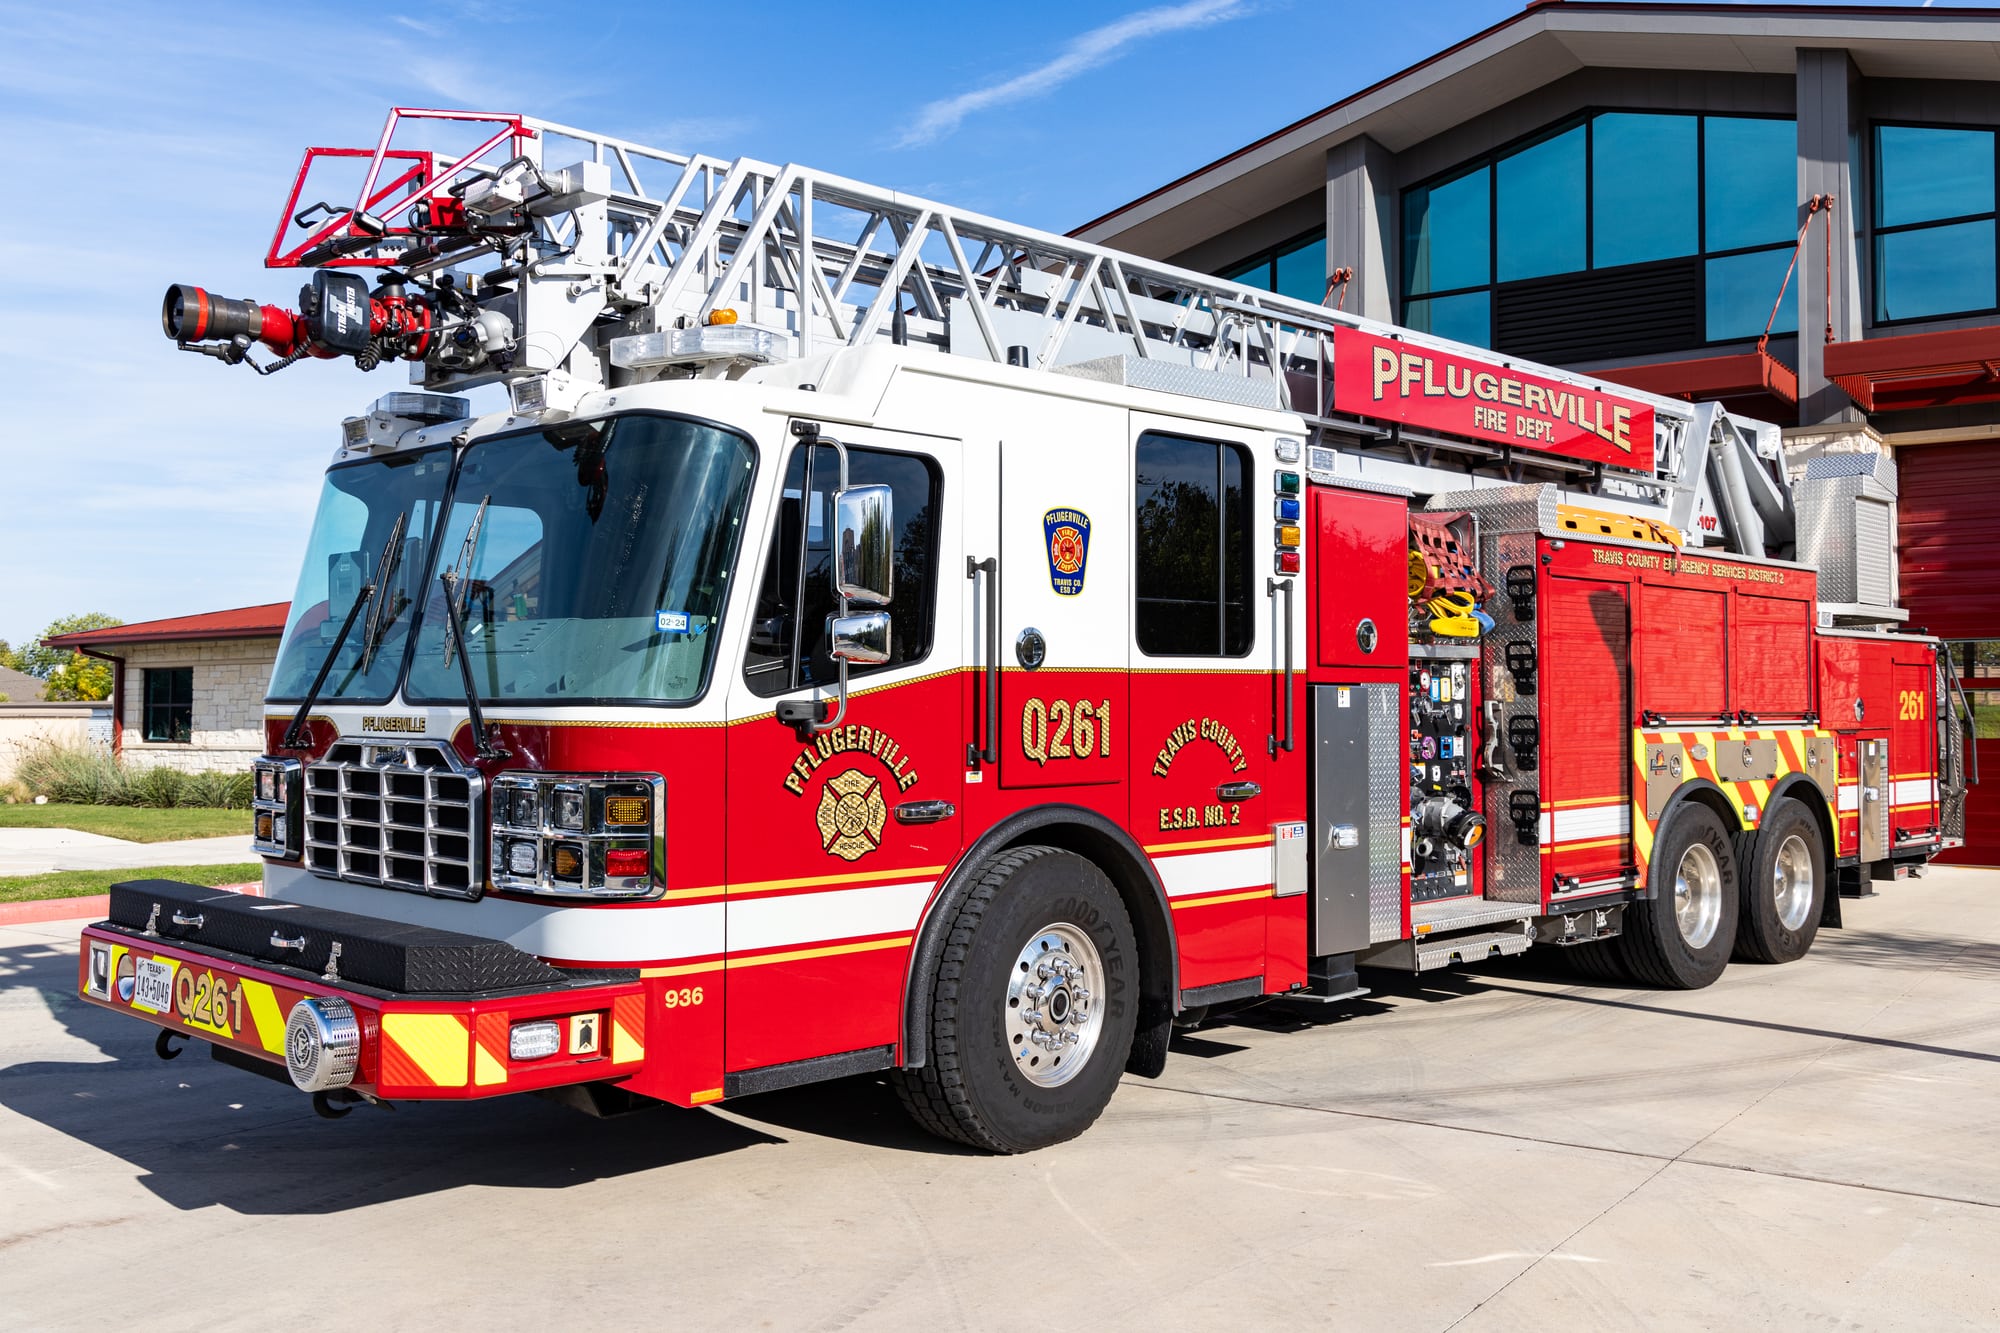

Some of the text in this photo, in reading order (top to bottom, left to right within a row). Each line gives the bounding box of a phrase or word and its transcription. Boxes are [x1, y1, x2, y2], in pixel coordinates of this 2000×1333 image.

[1372, 345, 1631, 453] PFLUGERVILLE
[1473, 405, 1555, 443] FIRE DEPT.
[1045, 511, 1088, 529] PFLUGERVILLE
[1592, 548, 1785, 585] TRAVIS COUNTY EMRGENCY SERVICES DISTRICT 2
[1899, 690, 1925, 721] 261
[362, 716, 426, 733] PFLUGERVILLE
[1021, 697, 1110, 768] Q261
[782, 724, 920, 799] PFLUGERVILLE
[1152, 717, 1248, 780] TRAVIS COUNTY
[1159, 803, 1240, 832] E.S.D. NO. 2
[146, 962, 163, 975] TEXAS
[175, 966, 243, 1035] Q261
[664, 986, 704, 1009] 936
